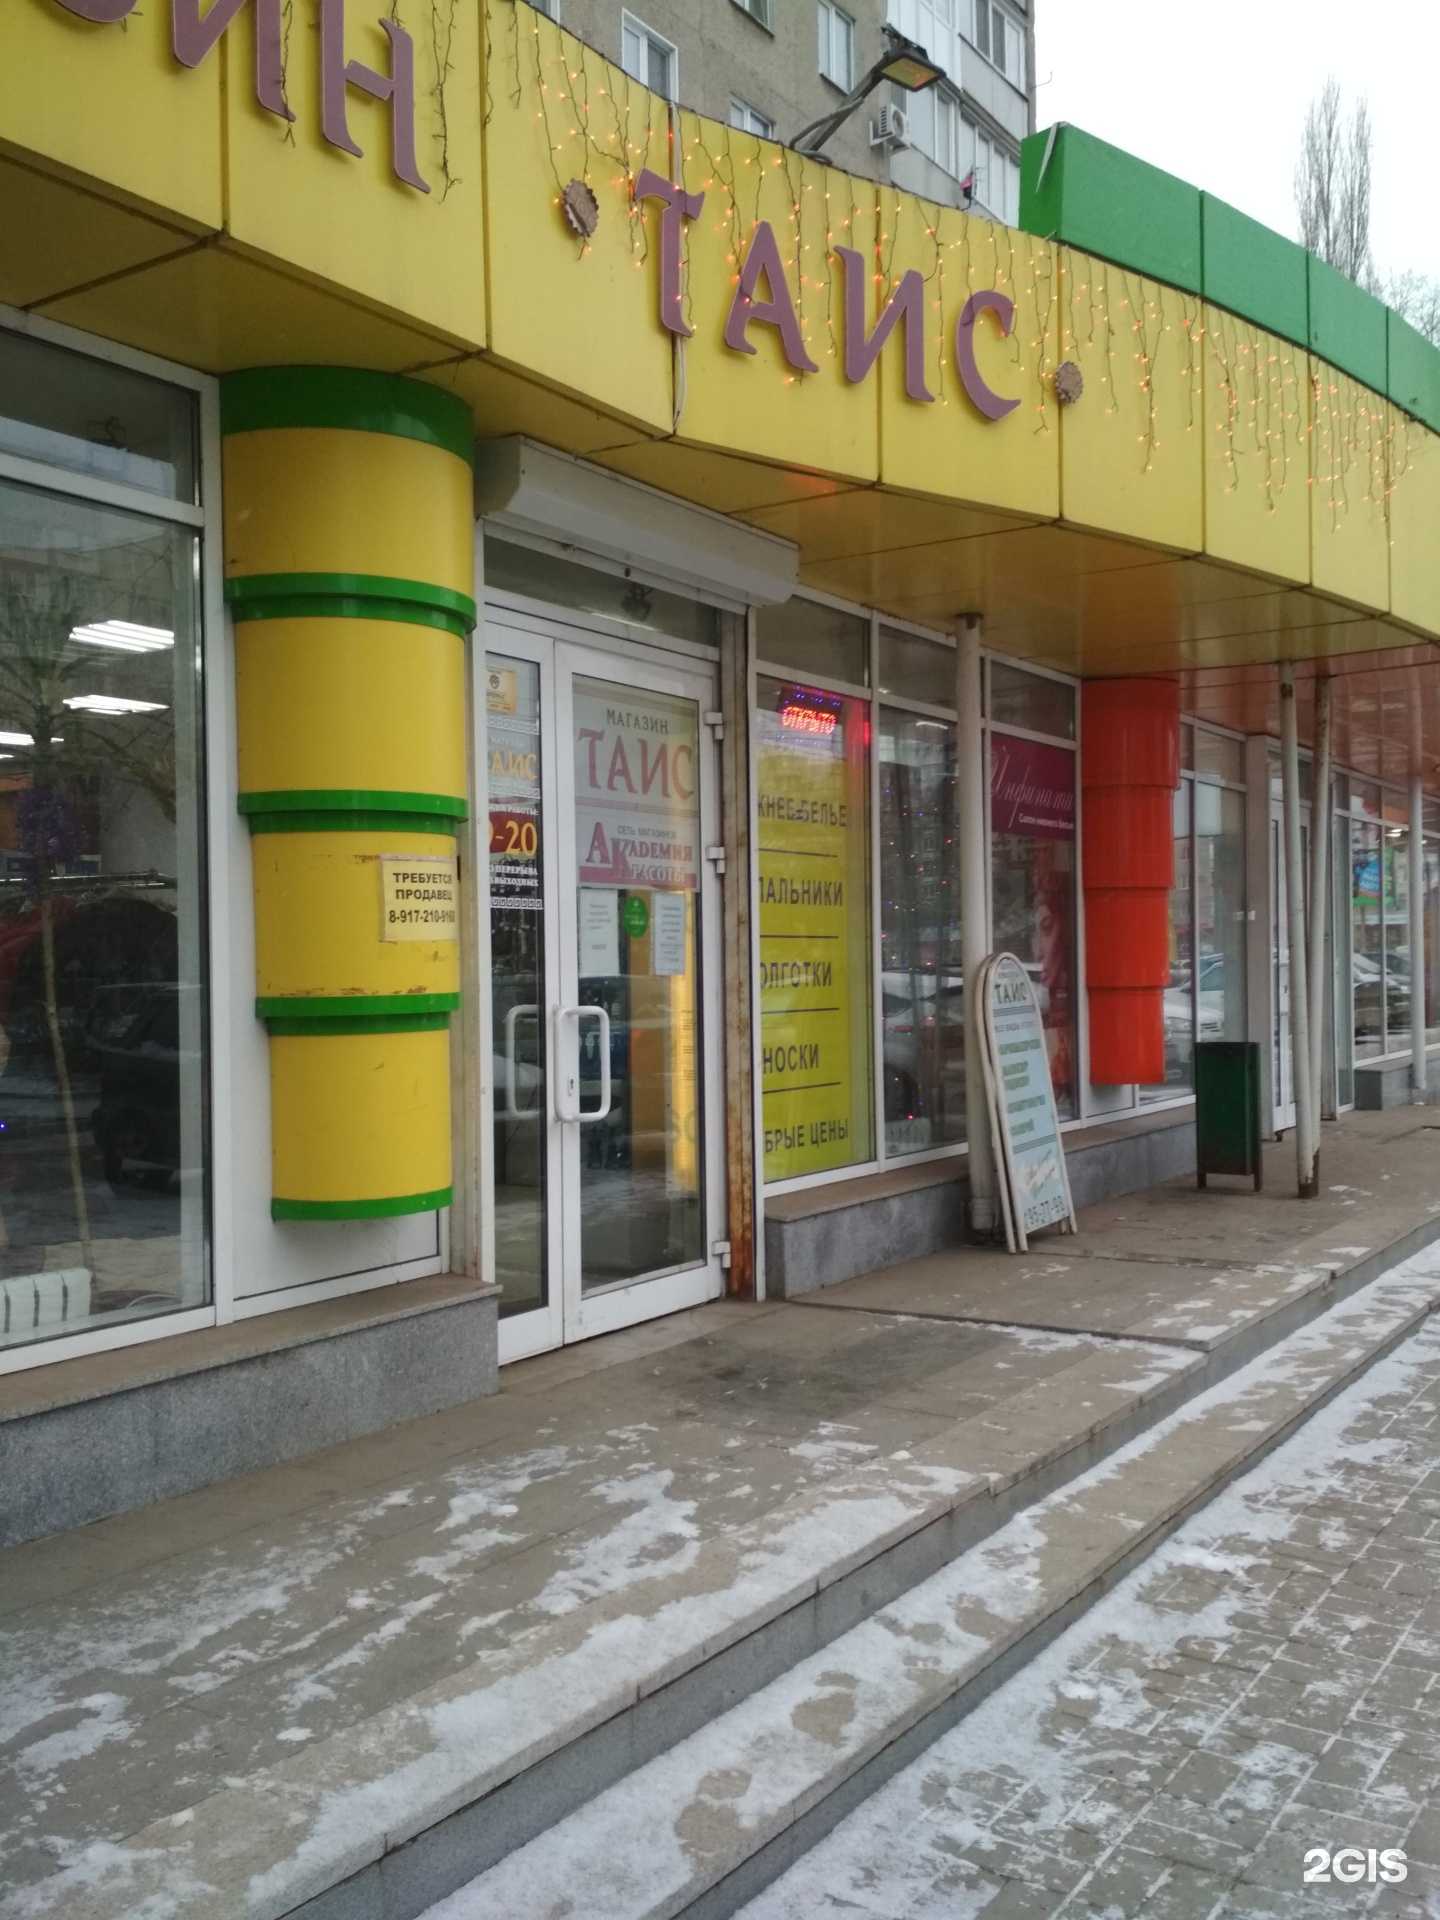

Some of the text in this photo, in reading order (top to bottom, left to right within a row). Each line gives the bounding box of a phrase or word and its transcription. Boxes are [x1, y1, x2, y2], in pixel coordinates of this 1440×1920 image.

[36, 0, 431, 194] ИН
[634, 167, 1022, 421] ТАИС
[606, 708, 669, 735] МАГАЗИН
[489, 750, 538, 780] АИС
[577, 727, 695, 800] ТАИС
[489, 820, 538, 856] -20
[762, 1044, 819, 1074] НОСКИ
[764, 1118, 849, 1153] БРЫЕ ЦЕНЫ
